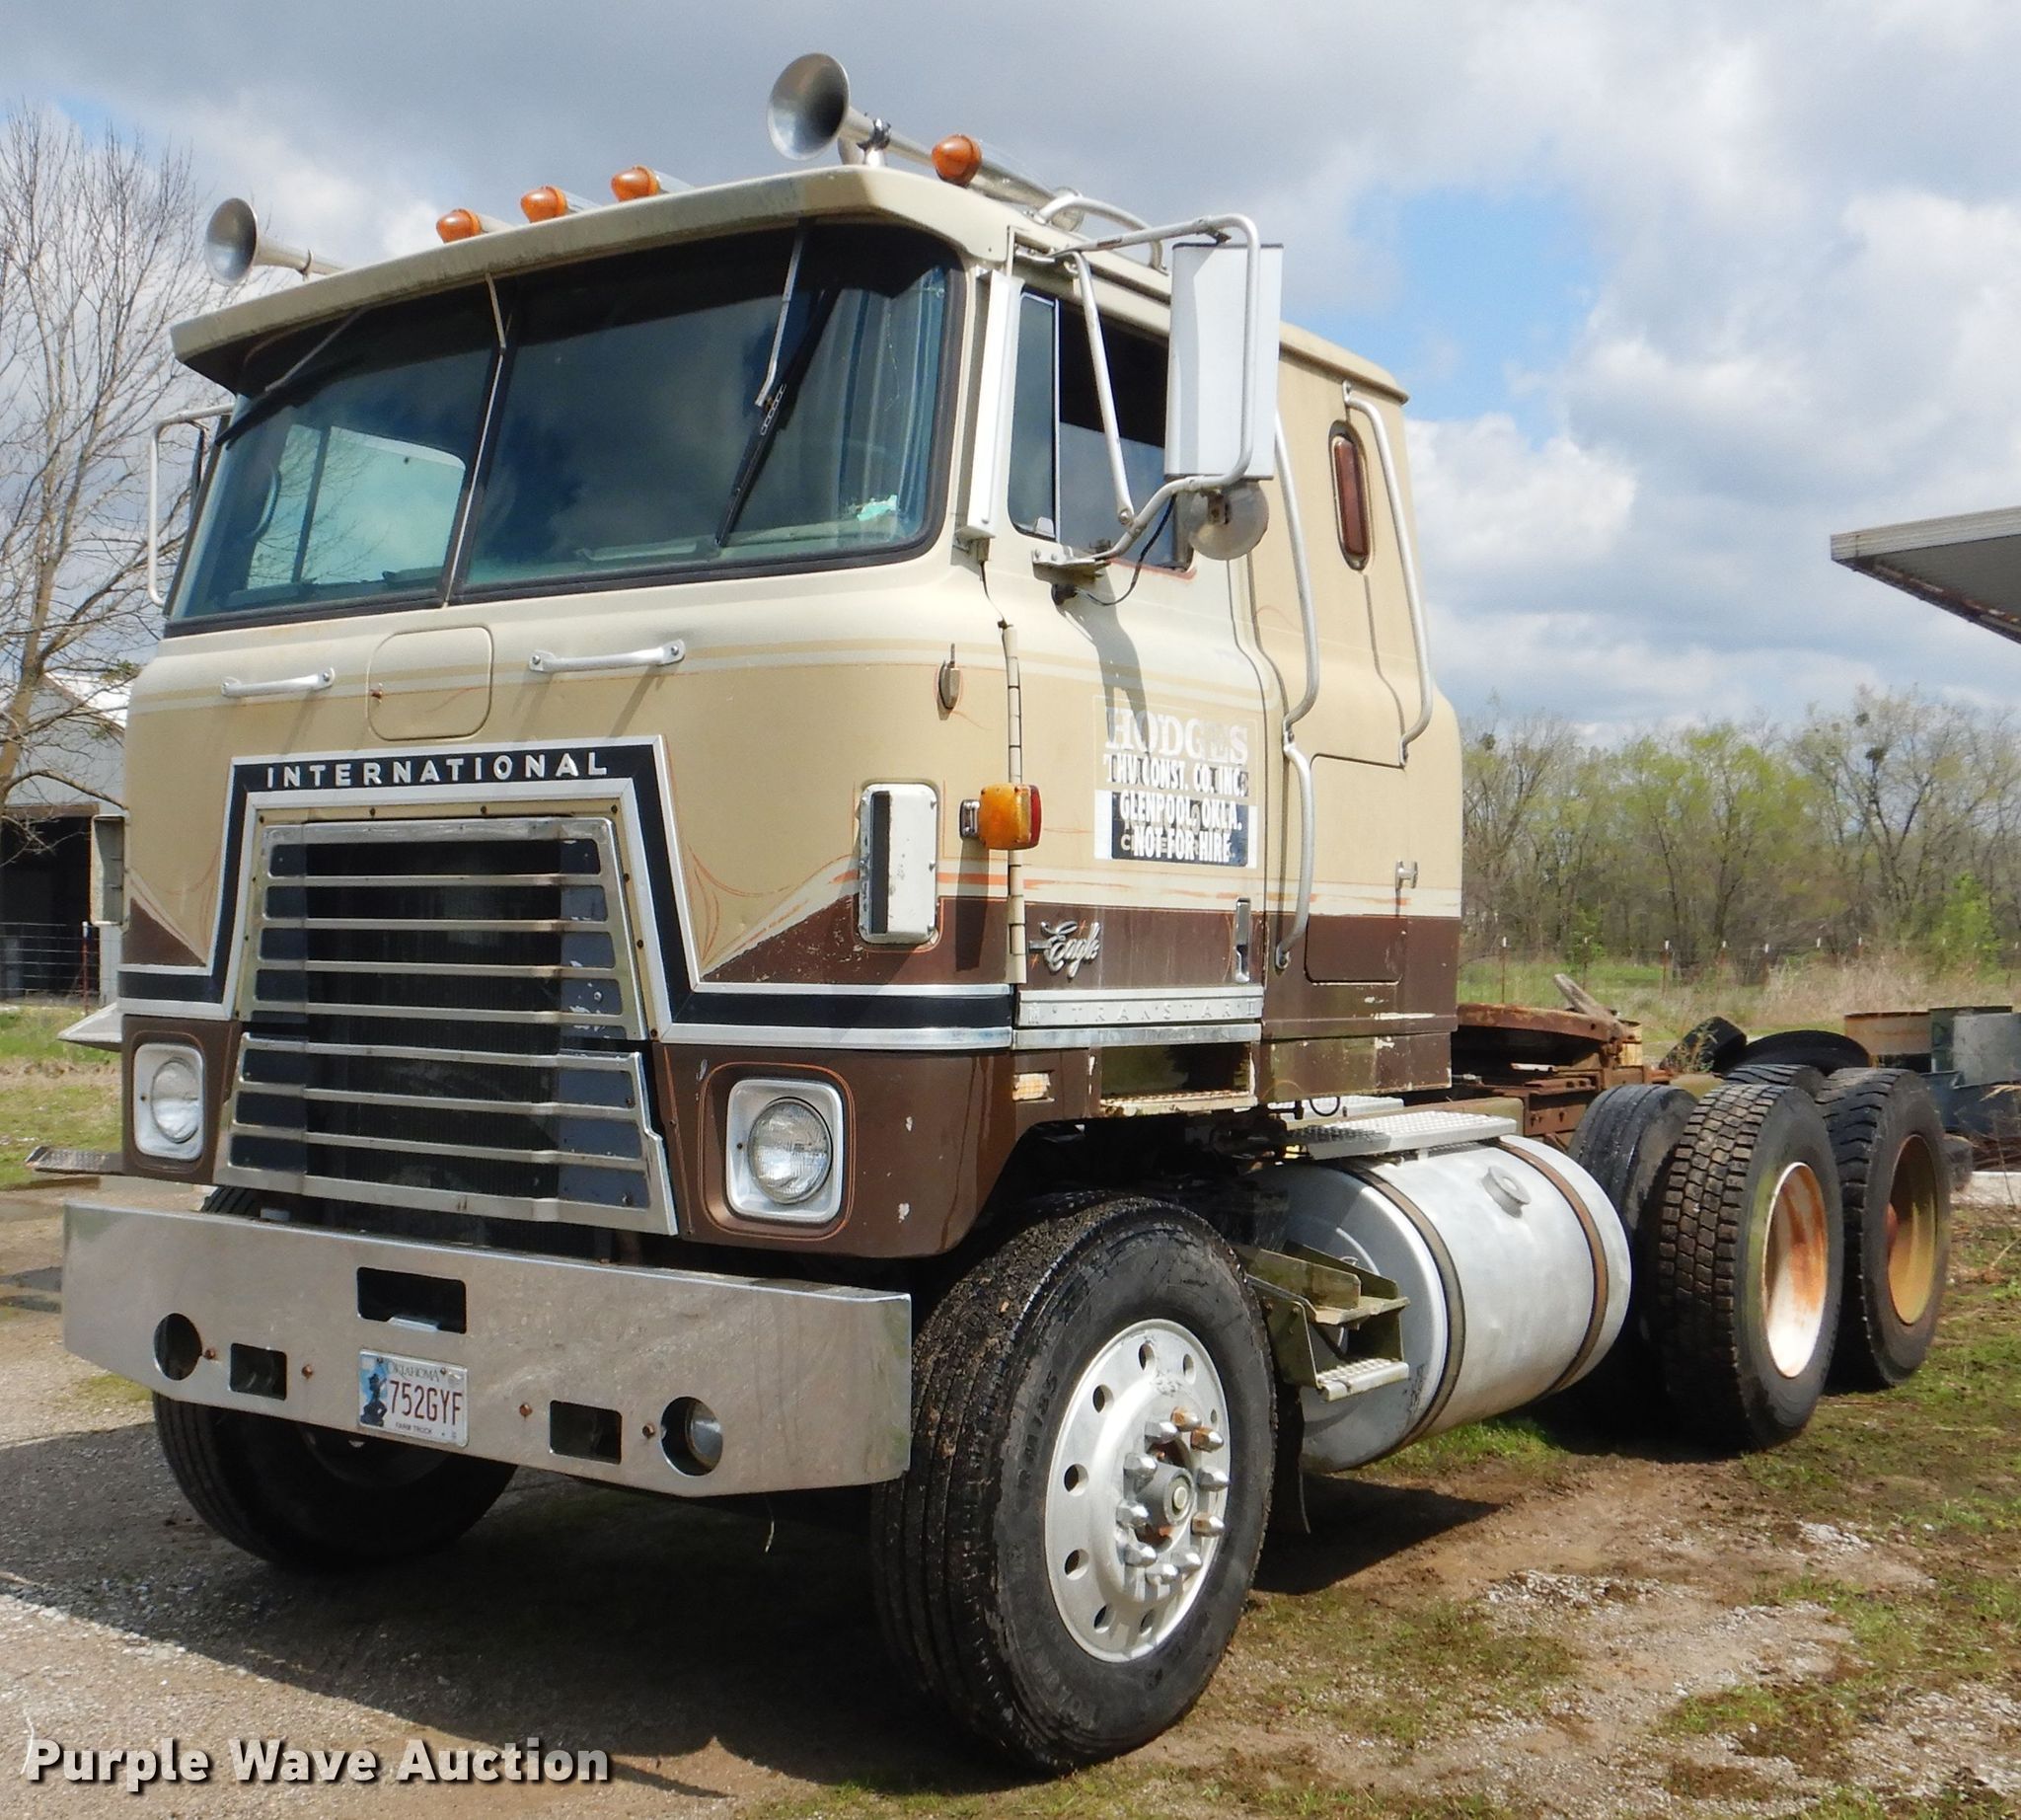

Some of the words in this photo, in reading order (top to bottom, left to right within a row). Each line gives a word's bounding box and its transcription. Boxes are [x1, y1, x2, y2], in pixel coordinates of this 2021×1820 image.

[267, 752, 607, 788] INTERNATIONAL
[1134, 826, 1162, 858] NOT
[1167, 829, 1195, 860] FOR
[388, 1360, 439, 1382] OKLAHOMA
[390, 1380, 463, 1425] 752GYF
